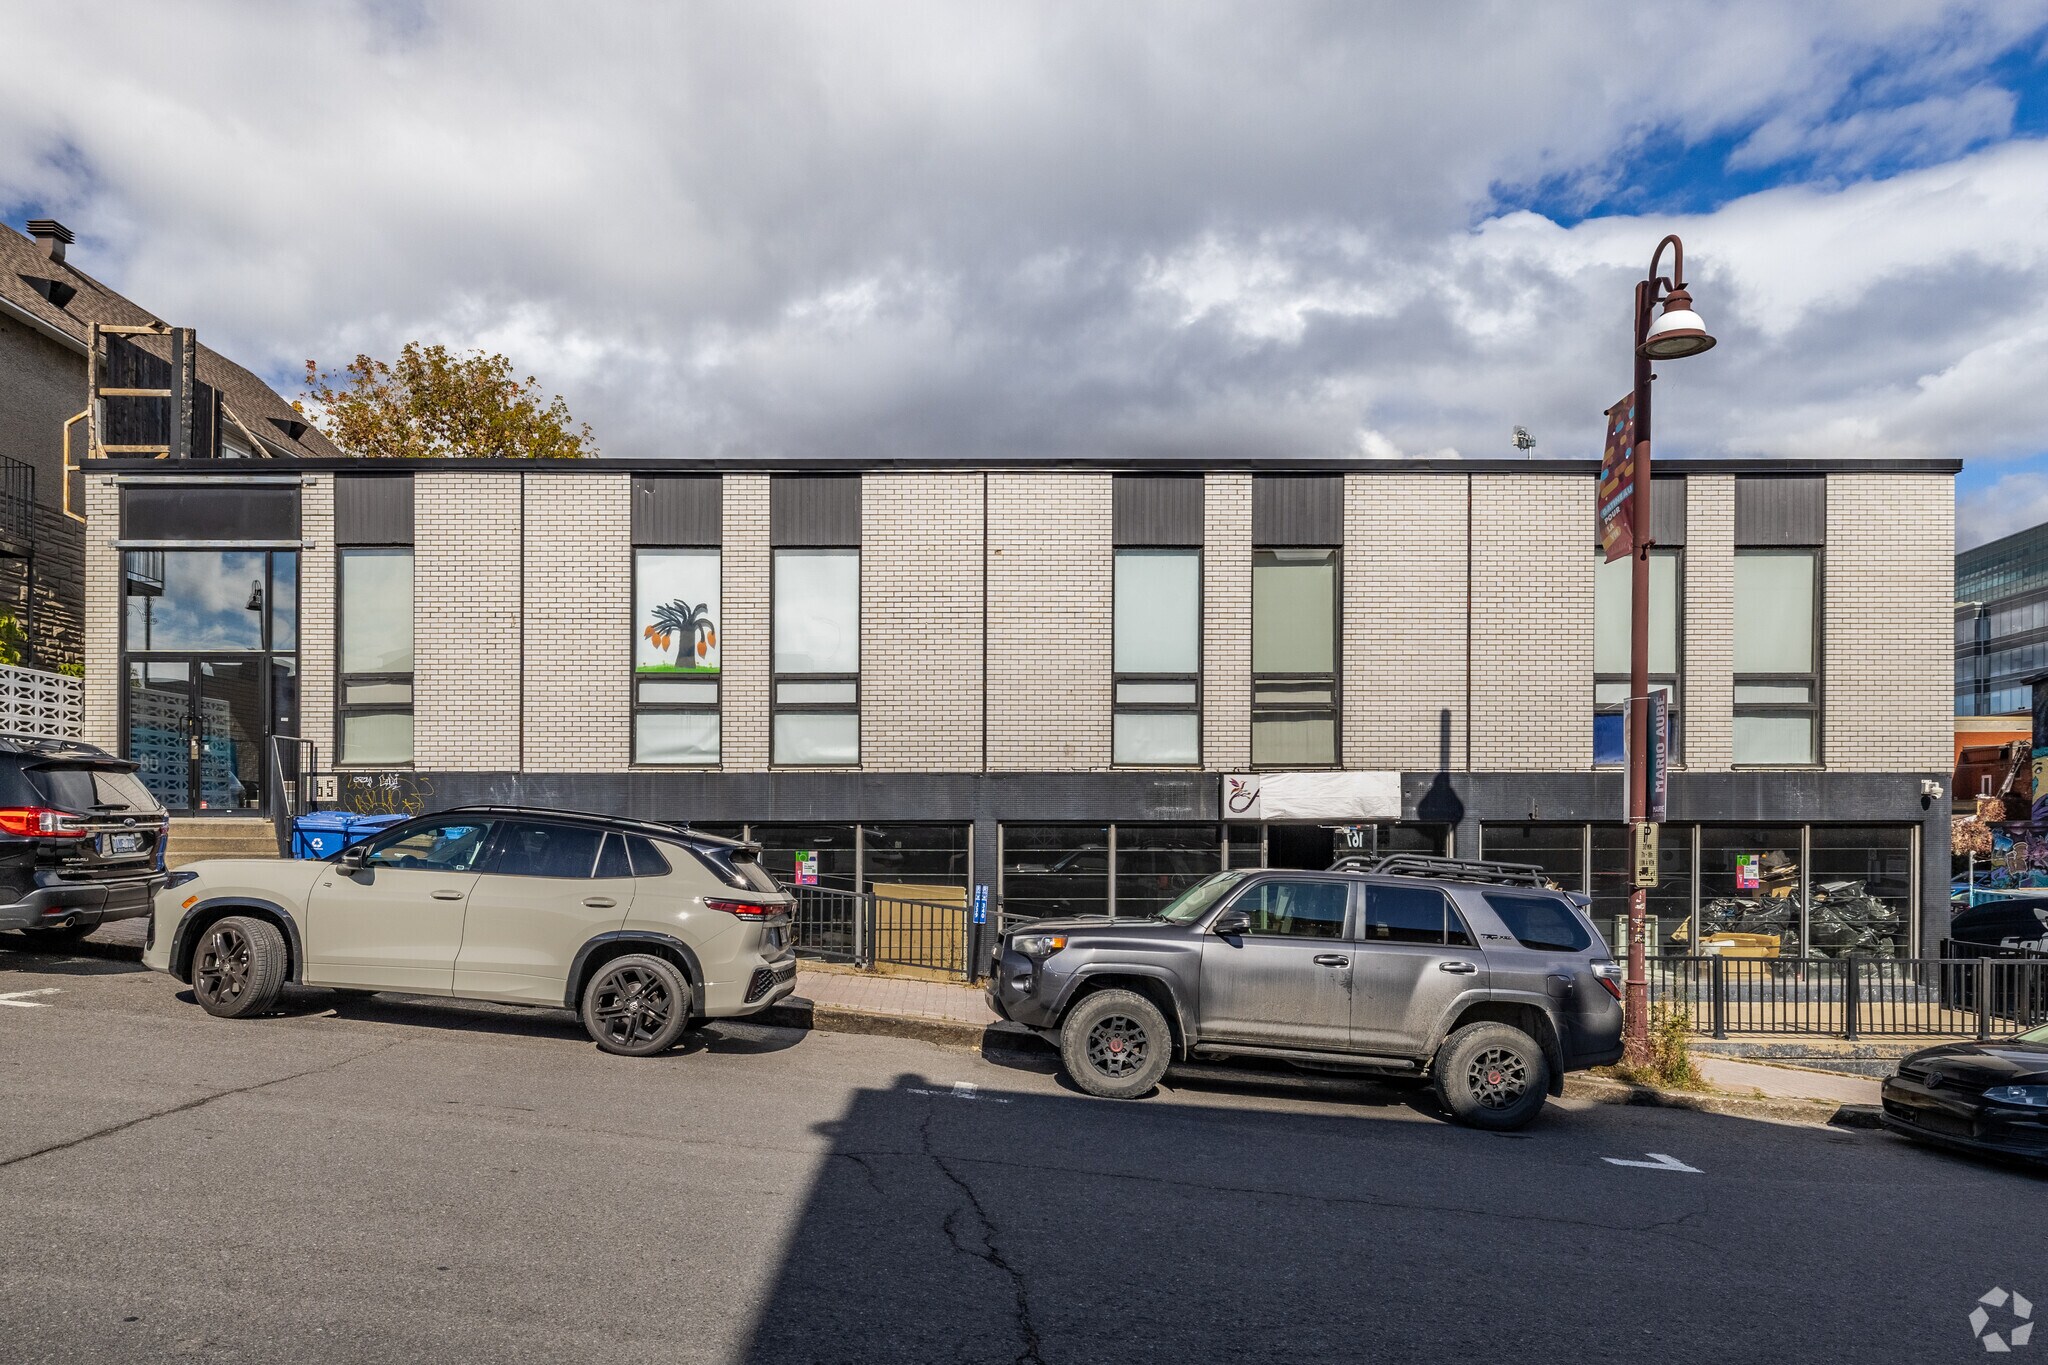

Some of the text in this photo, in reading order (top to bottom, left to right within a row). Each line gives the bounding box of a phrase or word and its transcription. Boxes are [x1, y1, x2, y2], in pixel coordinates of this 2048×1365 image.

[1602, 486, 1633, 516] GATINEAU
[1604, 505, 1621, 525] POUR
[1606, 523, 1615, 534] LA
[1653, 694, 1665, 793] MARIO AUBÉ
